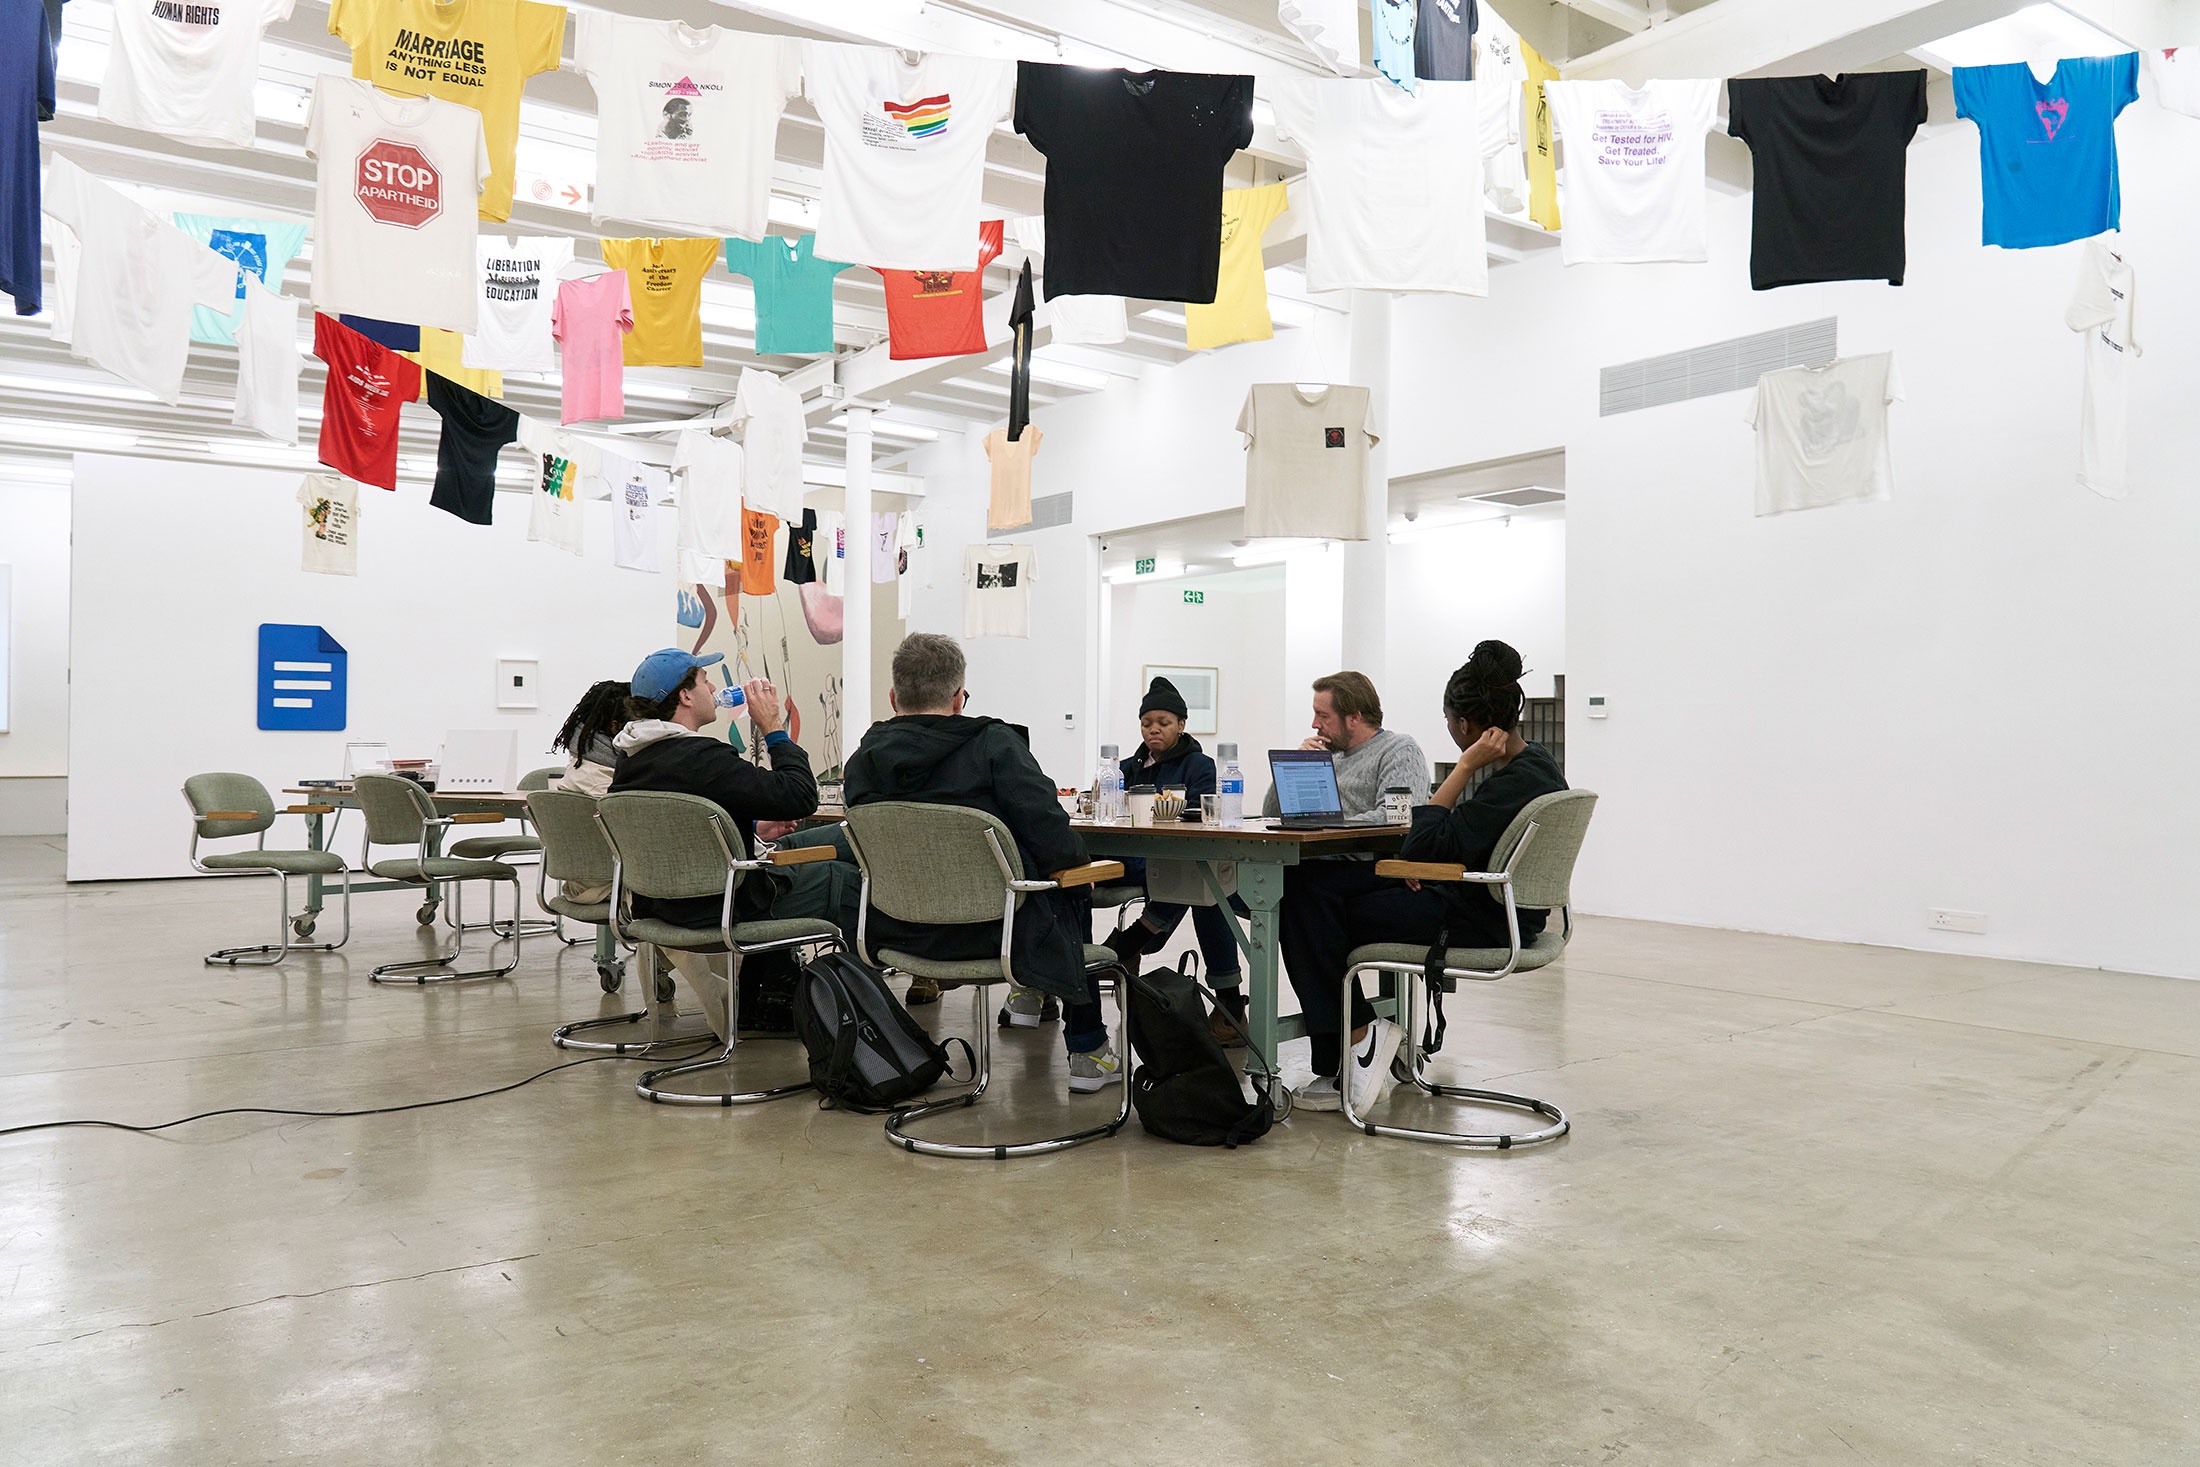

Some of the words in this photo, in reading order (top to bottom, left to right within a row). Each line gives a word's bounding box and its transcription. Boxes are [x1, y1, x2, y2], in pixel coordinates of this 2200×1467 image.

[152, 0, 183, 23] HUMAN
[185, 5, 220, 25] RIGHTS
[395, 29, 484, 64] MARRIAGE
[388, 49, 451, 68] ANYTHING
[455, 61, 487, 75] LESS
[385, 61, 398, 71] IS
[404, 65, 436, 81] NOT
[442, 72, 484, 87] EQUAL
[648, 81, 672, 89] SIMON
[1592, 132, 1608, 143] Get
[1610, 134, 1641, 144] Tested
[1643, 134, 1656, 144] for
[1657, 132, 1674, 143] HIV.
[1605, 145, 1621, 155] Get
[1623, 146, 1660, 156] Treated.
[1598, 155, 1621, 165] Save
[1623, 158, 1644, 166] Your
[1646, 155, 1666, 165] Life!
[364, 158, 434, 191] STOP
[359, 185, 438, 209] APARTHEID
[486, 258, 541, 272] LIBERATION
[486, 286, 538, 301] EDUCATION
